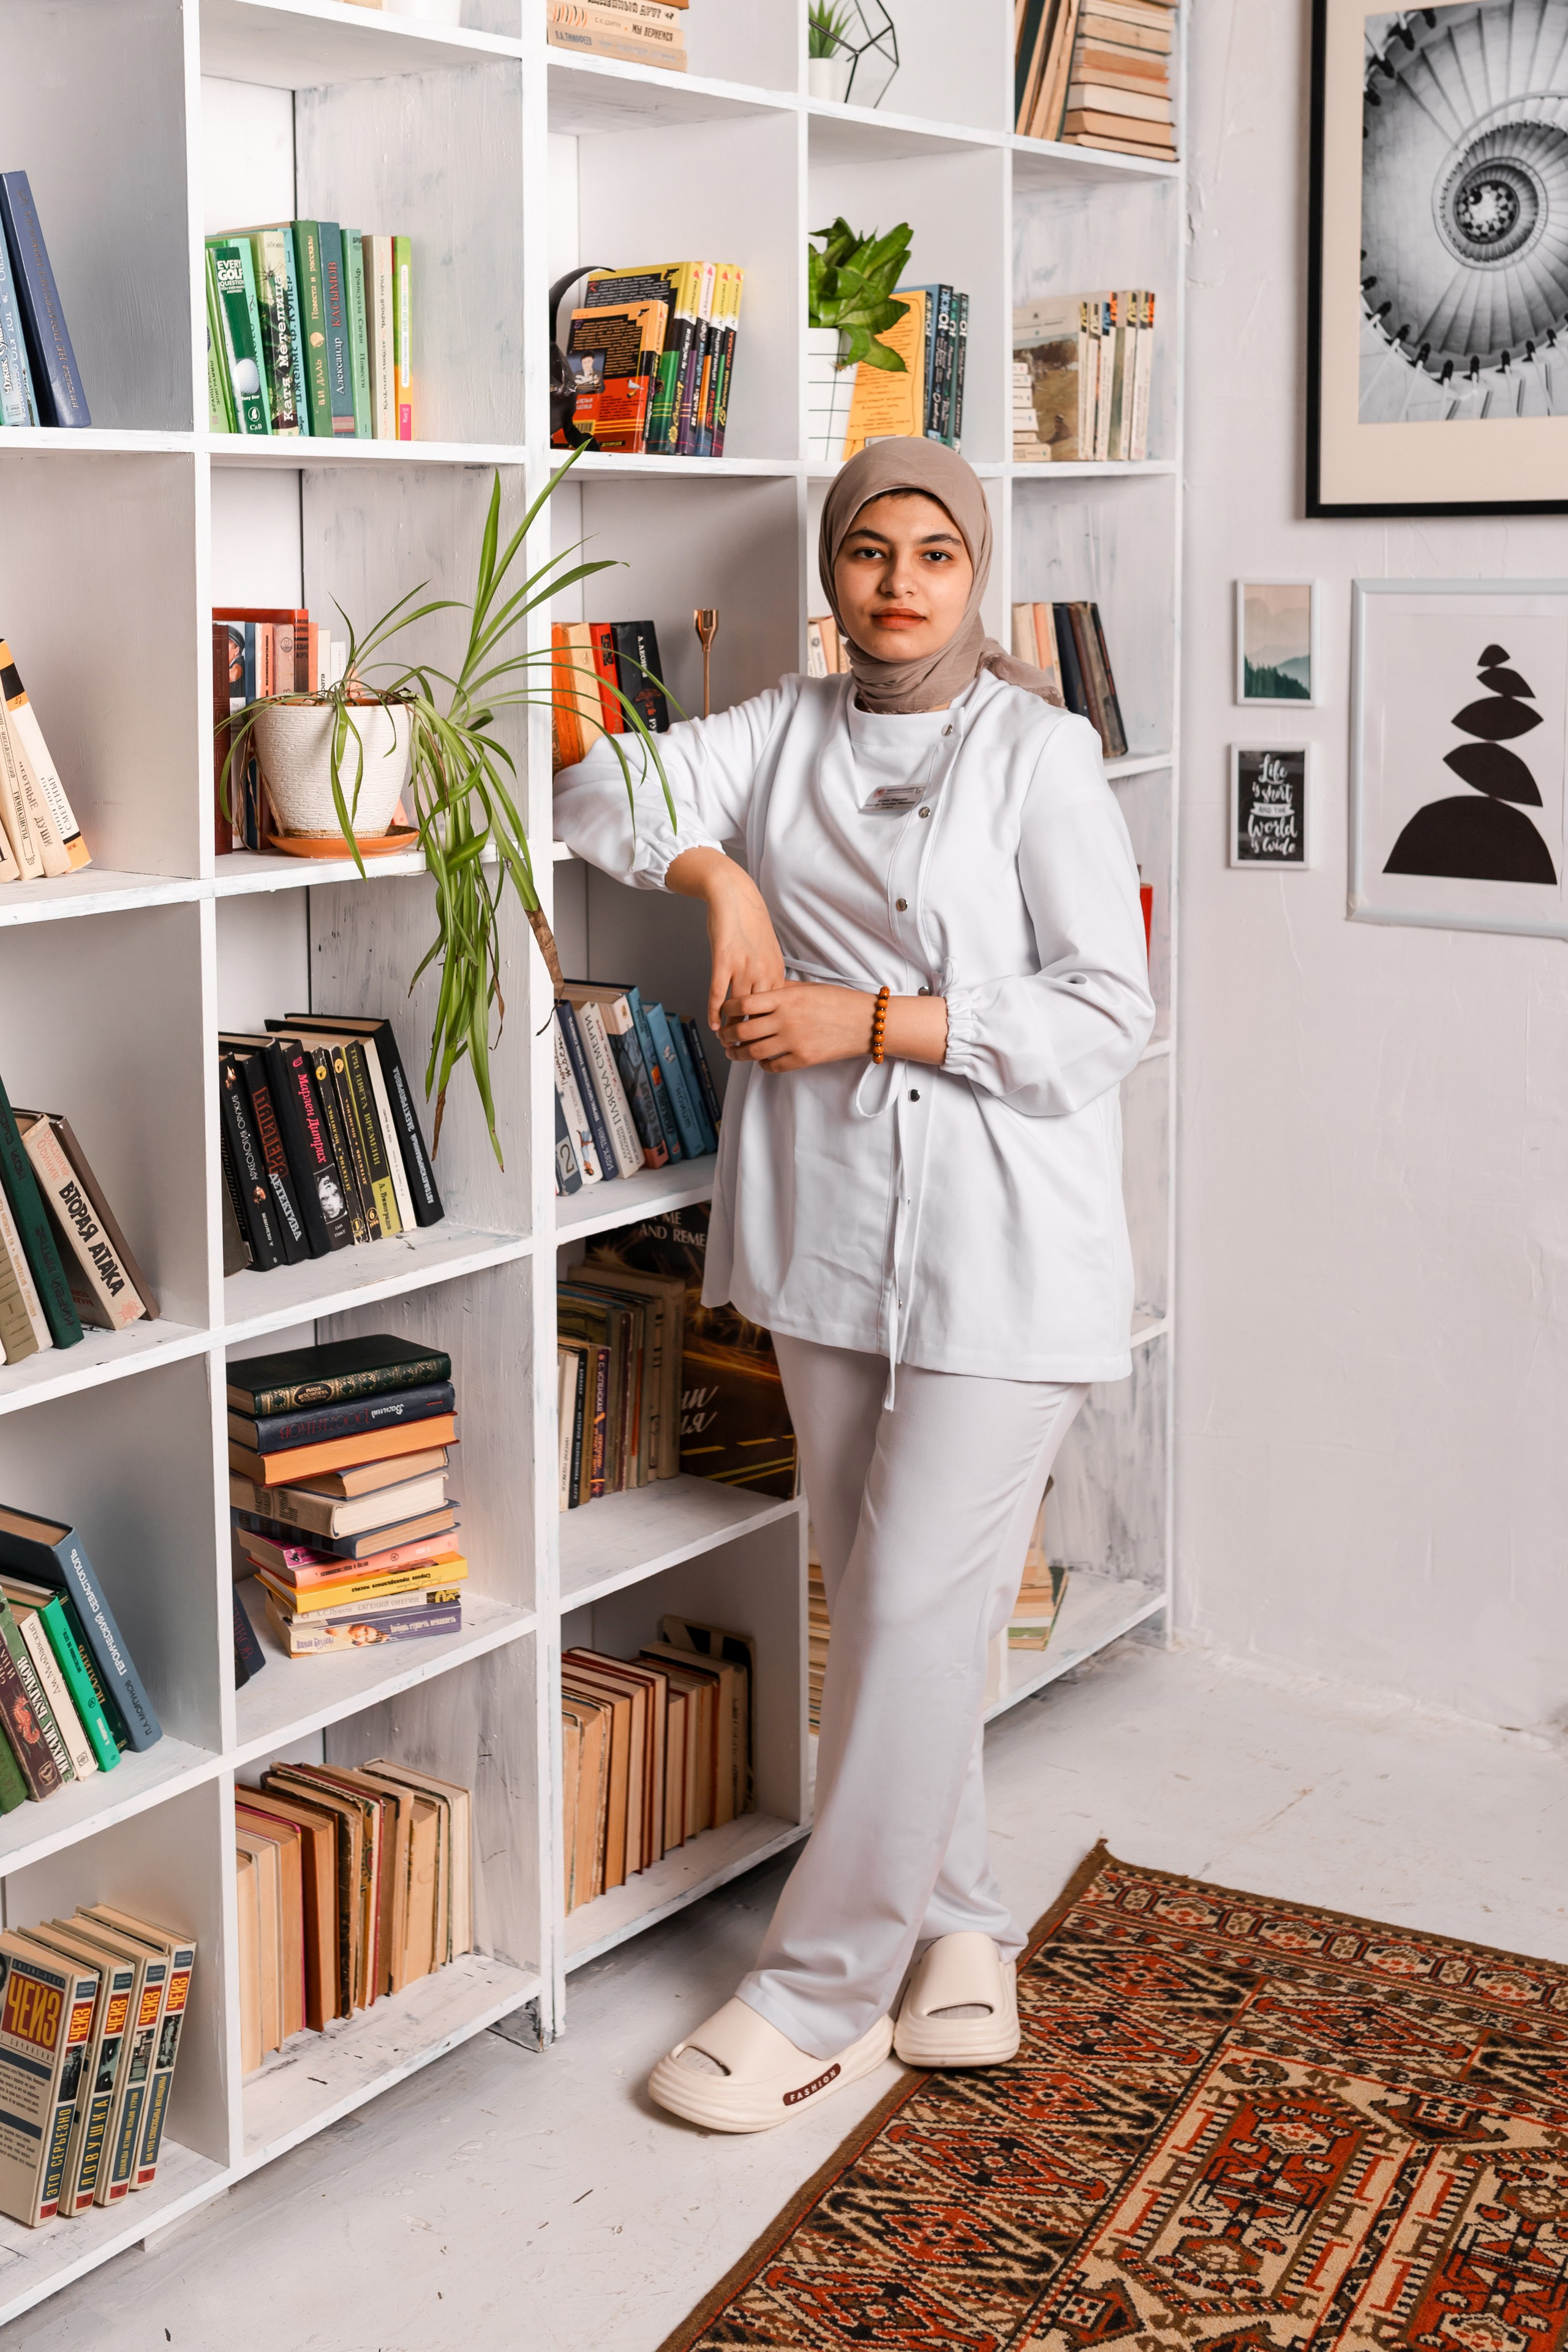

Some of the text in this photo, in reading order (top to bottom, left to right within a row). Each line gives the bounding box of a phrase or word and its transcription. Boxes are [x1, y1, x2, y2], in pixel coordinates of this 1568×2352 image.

[217, 259, 241, 270] EVERY
[307, 235, 317, 272] рассказы
[217, 268, 243, 281] GOLF
[327, 261, 345, 394] Александр КАСЫМОВ
[274, 275, 293, 421] Катя Метелица
[1258, 753, 1288, 785] Life
[47, 774, 72, 831] СМЕРТНЫЕ
[1262, 783, 1294, 804] short
[13, 791, 28, 840] ГИМНАЗИСТЫ
[34, 815, 53, 847] ДУШИ
[584, 1014, 621, 1126] ПЛЯСКА СМЕРТИ
[298, 1073, 327, 1163] Марлен Дитрих
[350, 1047, 380, 1166] ТРИ ЦВЕТА ВРЕМЕНИ
[231, 1094, 258, 1180] АРХЕОЛОГИЯ ОРУЖИЯ
[327, 1105, 351, 1191] ДЕТЕКТИВ ПОЛИТИКА
[345, 1099, 368, 1185] ДЕТЕКТИВ ПОЛИТИКА
[393, 1066, 435, 1204] АВТОМАТИЗИРОВАННЫЙ ЭЛЕКТРОПРИВОД
[10, 1149, 25, 1182] МОЯ
[37, 1139, 59, 1182] ОСИНИН
[43, 1129, 70, 1178] ВЛАДИМИР
[560, 1144, 574, 1174] 2
[268, 1173, 302, 1242] ДЕТЕКТИВА
[381, 1196, 392, 1231] Виноградов
[58, 1180, 99, 1243] ВТОРАЯ
[88, 1241, 126, 1298] АТАКА
[638, 1223, 706, 1248] AND REME
[371, 1403, 405, 1419] Василий
[70, 1548, 101, 1612] СЕВАСТОПОЛЬ
[351, 1584, 370, 1593] месяца
[371, 1575, 410, 1589] тринадцатого
[357, 1599, 390, 1611] ЕВГЕНИЙ
[390, 1597, 420, 1607] ОНЕГИН
[28, 1622, 56, 1681] Молдавский
[93, 1611, 127, 1676] ГЕРОИЧЕСКИЙ
[78, 1644, 107, 1705] ПСАЛТИРЬ
[17, 1656, 72, 1774] МИХАИЛ БУЛГАКОВ
[7, 1975, 61, 2047] ЧЕЙЗ
[140, 1991, 160, 2024] ЧЕЙЗ
[167, 1977, 188, 2010] ЧЕЙЗ
[69, 2007, 91, 2043] ЧЕЙЗ
[106, 1998, 128, 2033] ЧЕЙЗ
[129, 2091, 139, 2109] УТРОМ
[154, 2076, 167, 2107] ЖЕНЩИНЫ
[790, 2068, 837, 2103] FASHION
[121, 2128, 133, 2149] ЛЕТНИМ
[148, 2108, 161, 2139] СПОСОБНЫ
[46, 2107, 72, 2197] ЭТО СЕРЬЕЗНО
[81, 2098, 109, 2186] ЛОВУШКА
[145, 2152, 153, 2162] НА
[118, 2149, 130, 2177] ОДНАЖДЫ
